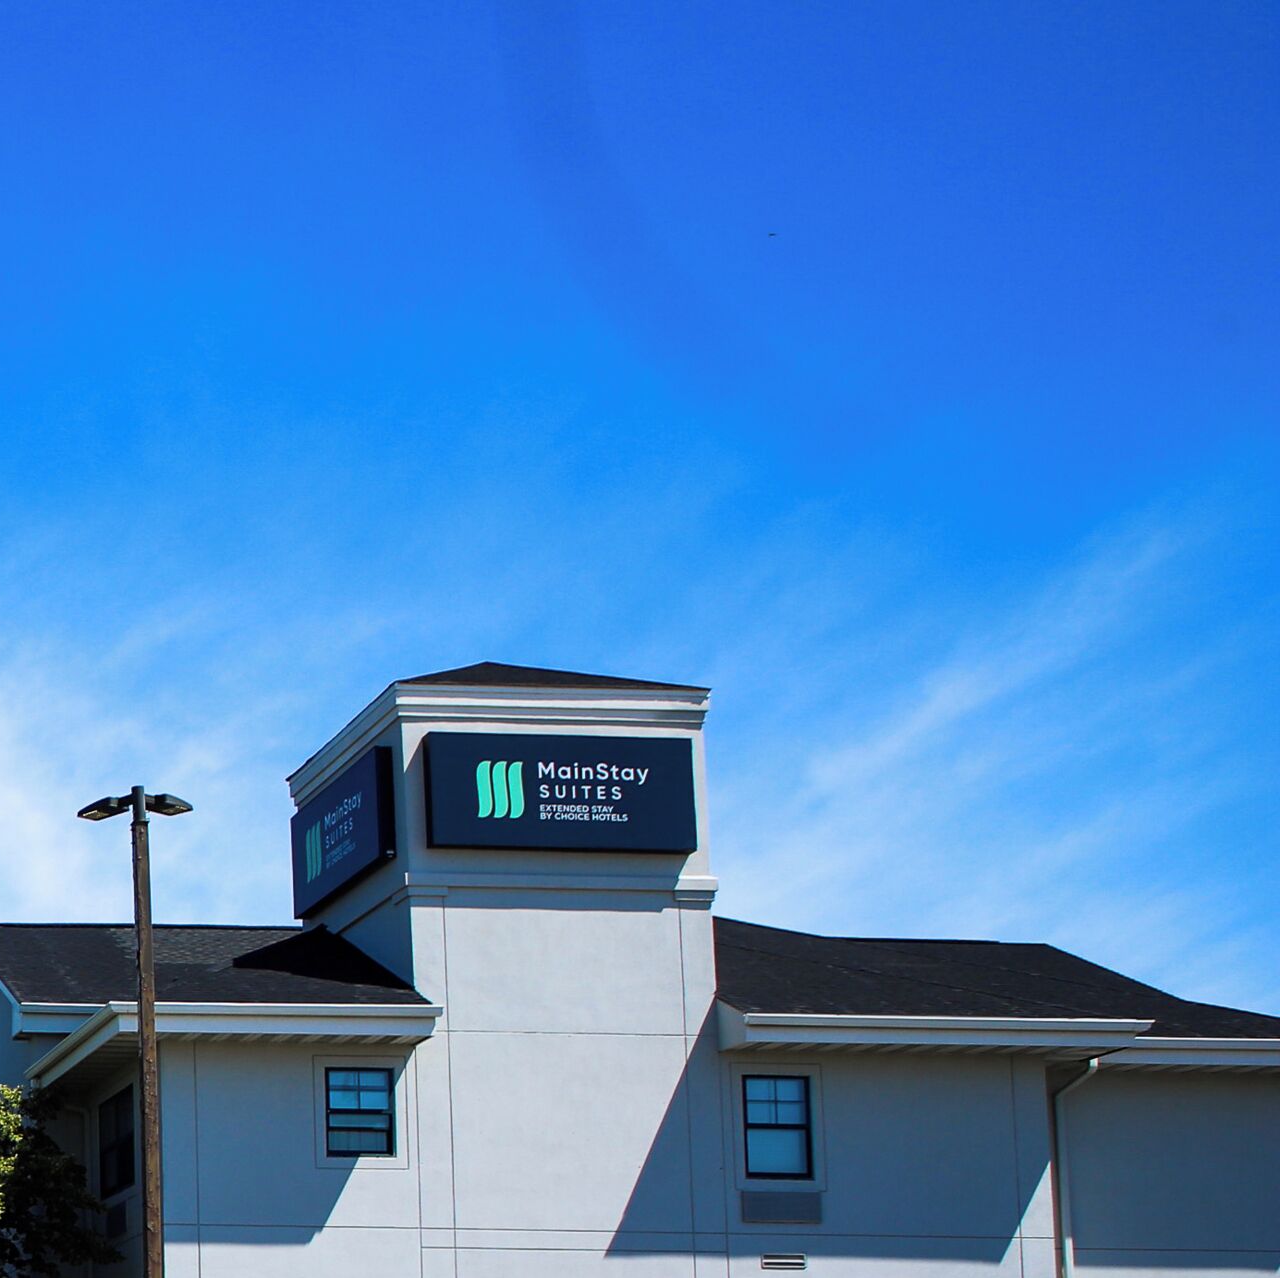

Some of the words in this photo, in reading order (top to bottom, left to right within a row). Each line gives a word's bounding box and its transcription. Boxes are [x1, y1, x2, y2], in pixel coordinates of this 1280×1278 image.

[538, 761, 649, 785] MainStay
[539, 784, 622, 800] SUITES
[324, 791, 362, 830] MainStay
[539, 804, 590, 813] EXTENDED
[591, 805, 614, 814] STAY
[540, 812, 553, 820] BY
[554, 812, 590, 821] CHOICE
[592, 813, 629, 822] HOTELS
[325, 817, 353, 849] SUITES
